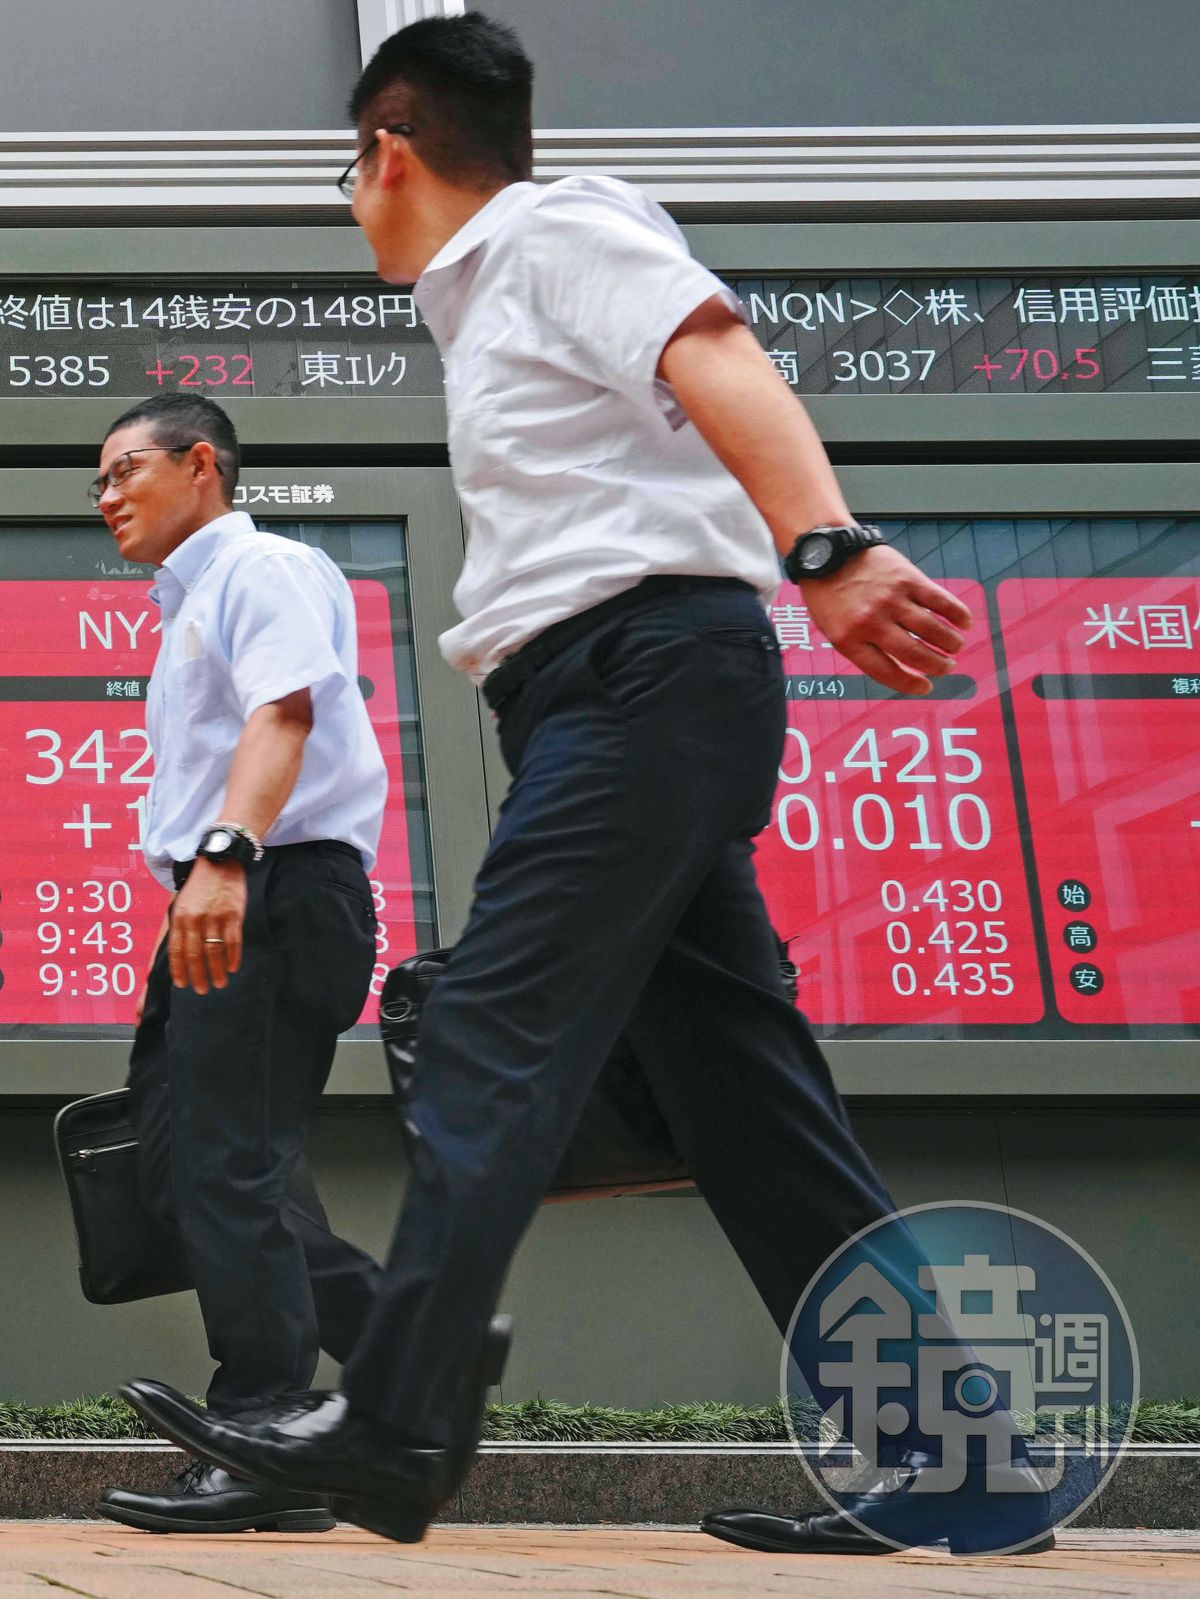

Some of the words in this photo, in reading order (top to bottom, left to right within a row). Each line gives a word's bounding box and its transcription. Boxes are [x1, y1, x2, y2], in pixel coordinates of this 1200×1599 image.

[745, 292, 877, 335] NQN>
[9, 355, 110, 386] 5385
[147, 354, 254, 386] +232
[832, 349, 936, 382] 3037
[975, 348, 1100, 380] +70.5
[232, 483, 335, 504] コスモ証券
[79, 610, 162, 650] NY
[765, 602, 833, 651] 債
[1083, 603, 1200, 650] 米国
[106, 680, 141, 697] 終値
[25, 728, 154, 785] 342
[778, 726, 983, 784] 0.425
[62, 795, 147, 851] +1
[763, 793, 992, 851] 0.010
[35, 880, 132, 913] 9:30
[881, 879, 1002, 913] 0.430
[1062, 884, 1085, 905] 始
[37, 921, 133, 954] 9:43
[886, 920, 1008, 954] 0.425
[1067, 926, 1091, 947] 高
[39, 963, 136, 996] 9:30
[892, 962, 1014, 996] 0.435
[1075, 968, 1098, 989] 安
